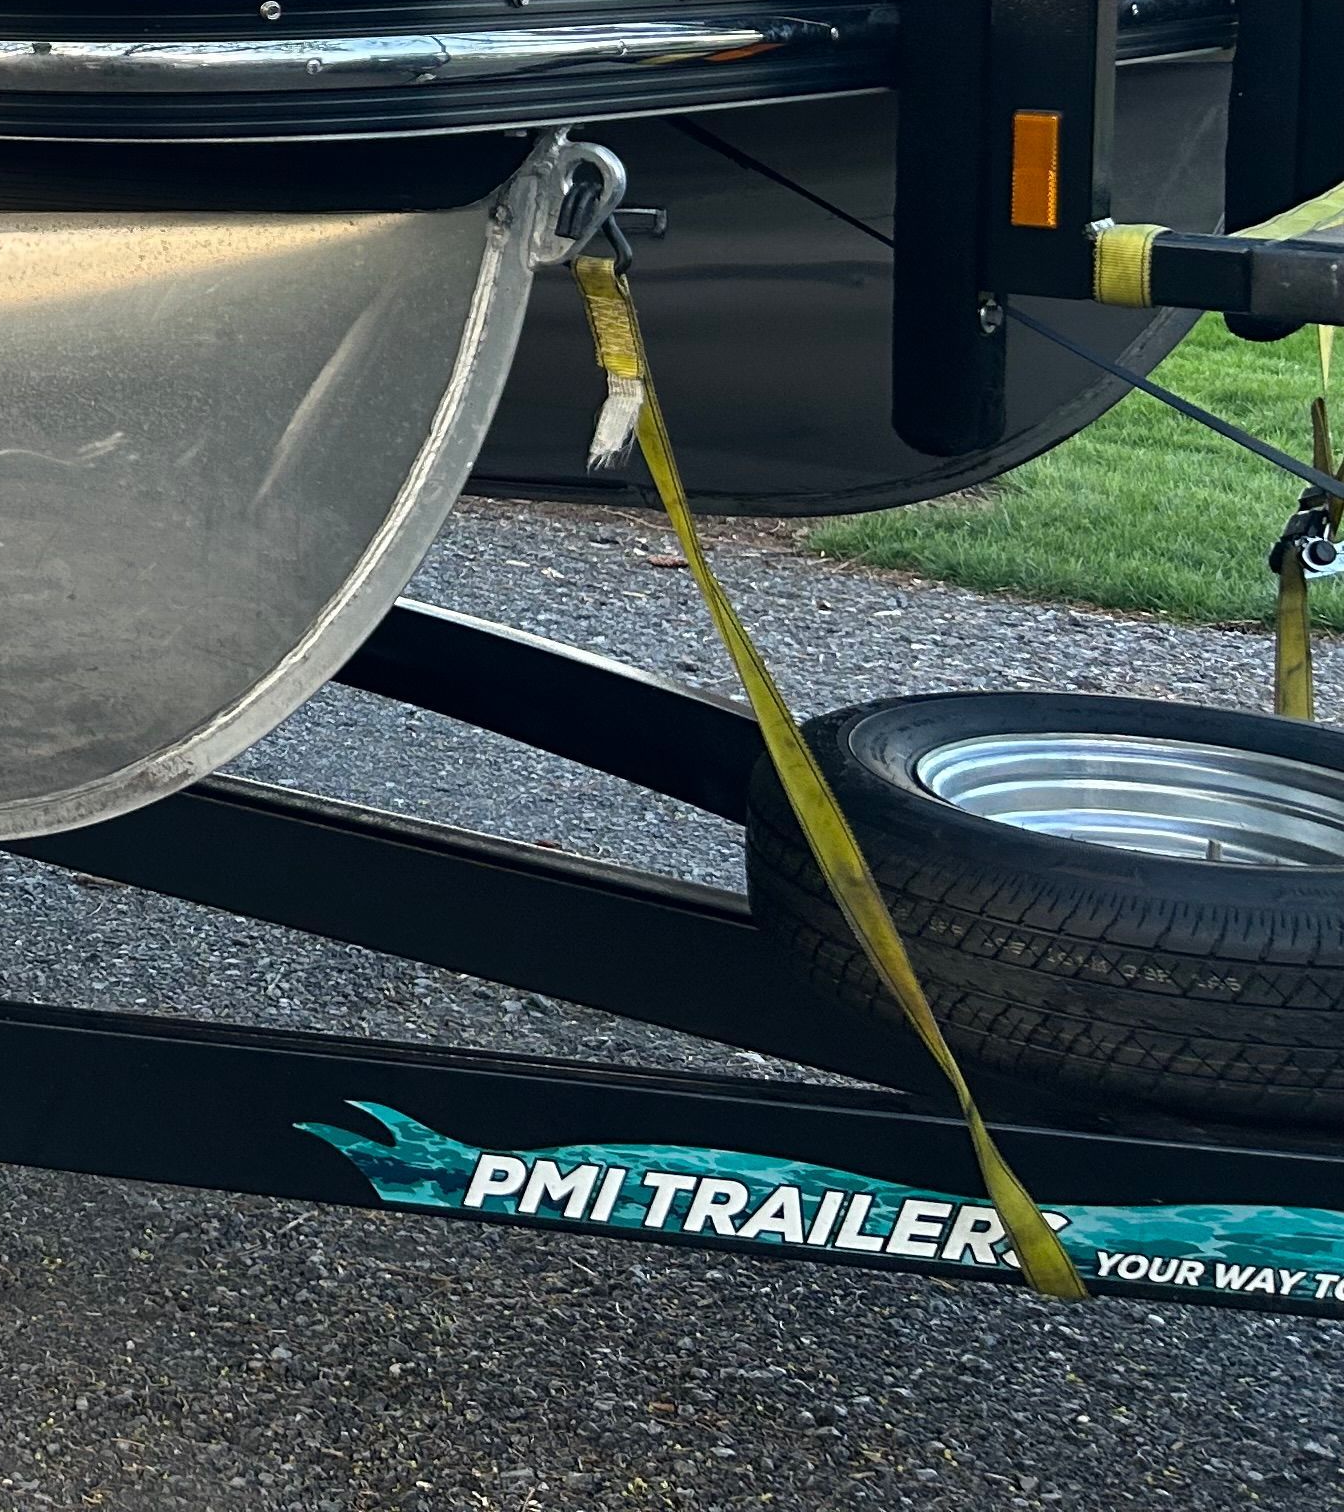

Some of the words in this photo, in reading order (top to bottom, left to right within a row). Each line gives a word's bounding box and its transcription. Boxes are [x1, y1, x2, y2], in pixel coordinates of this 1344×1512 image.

[462, 1154, 628, 1222] PMI
[1095, 1250, 1205, 1288] YOUR
[1214, 1262, 1308, 1298] WAY
